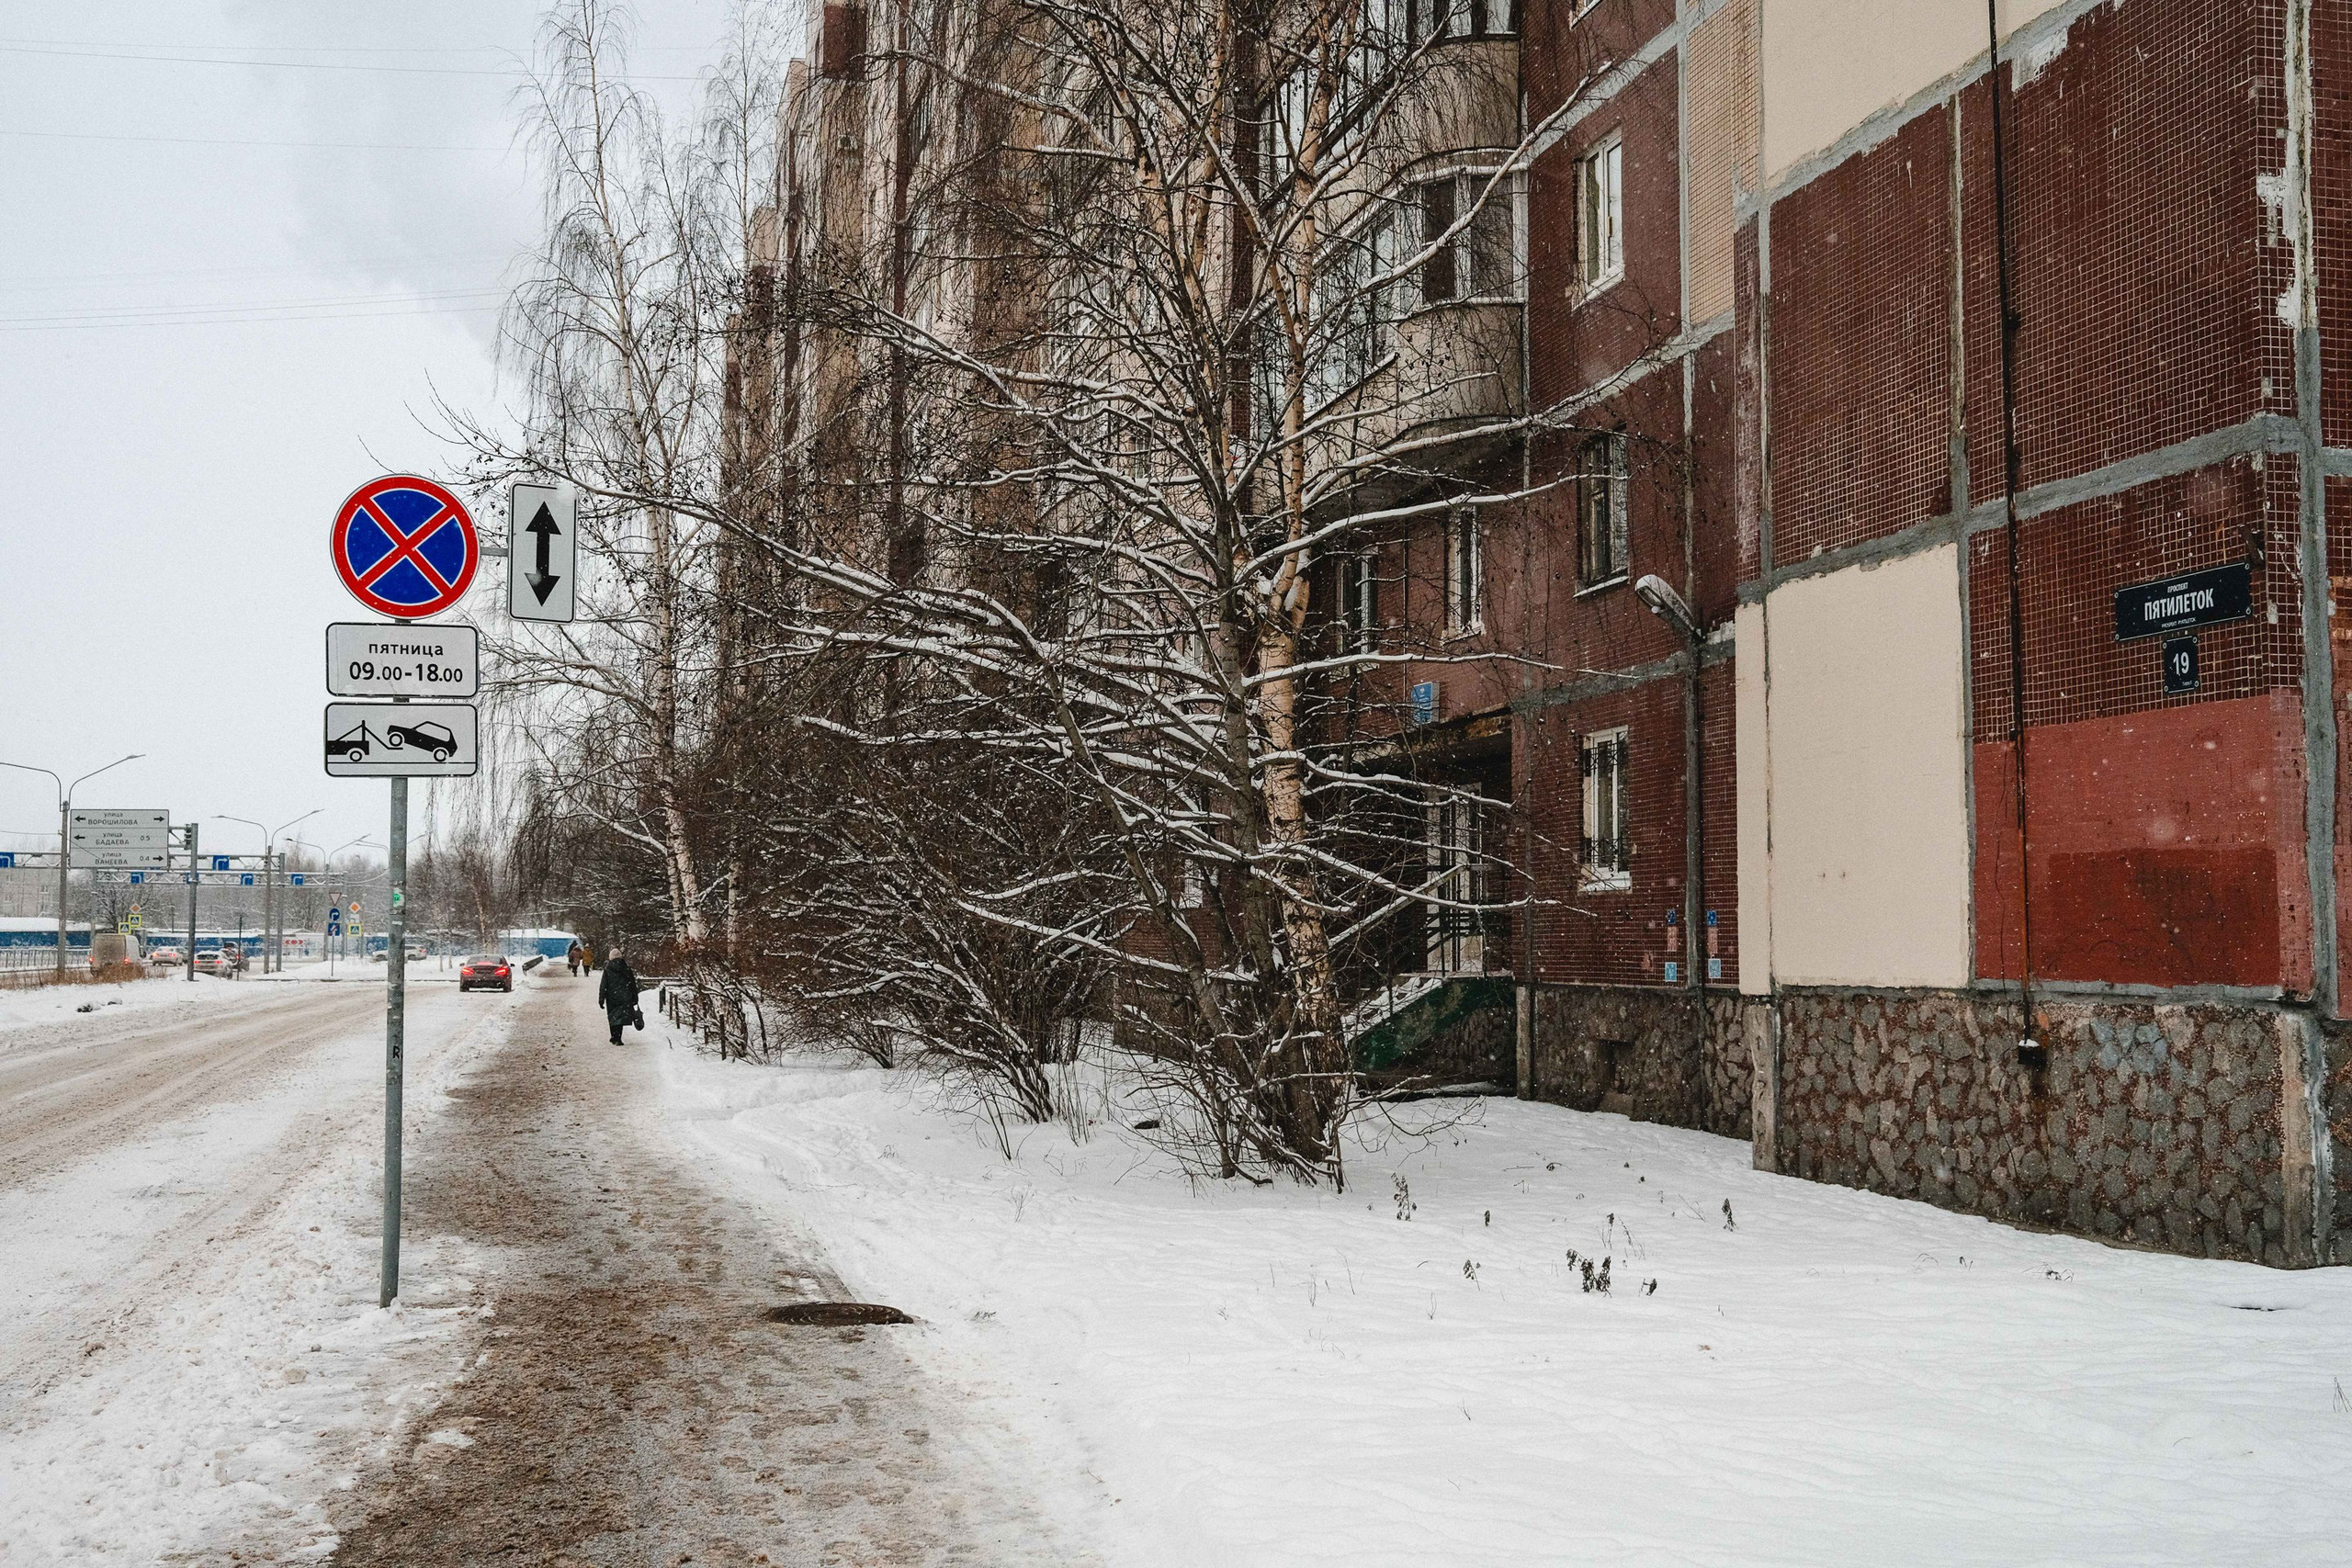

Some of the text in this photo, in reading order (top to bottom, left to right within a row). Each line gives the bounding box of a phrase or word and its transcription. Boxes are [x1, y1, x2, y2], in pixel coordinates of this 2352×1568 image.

[2144, 588, 2214, 621] ПЯТИЛЕТОК
[368, 643, 444, 657] пятница
[349, 661, 463, 682] 09.00-18.00
[2173, 651, 2189, 675] 19
